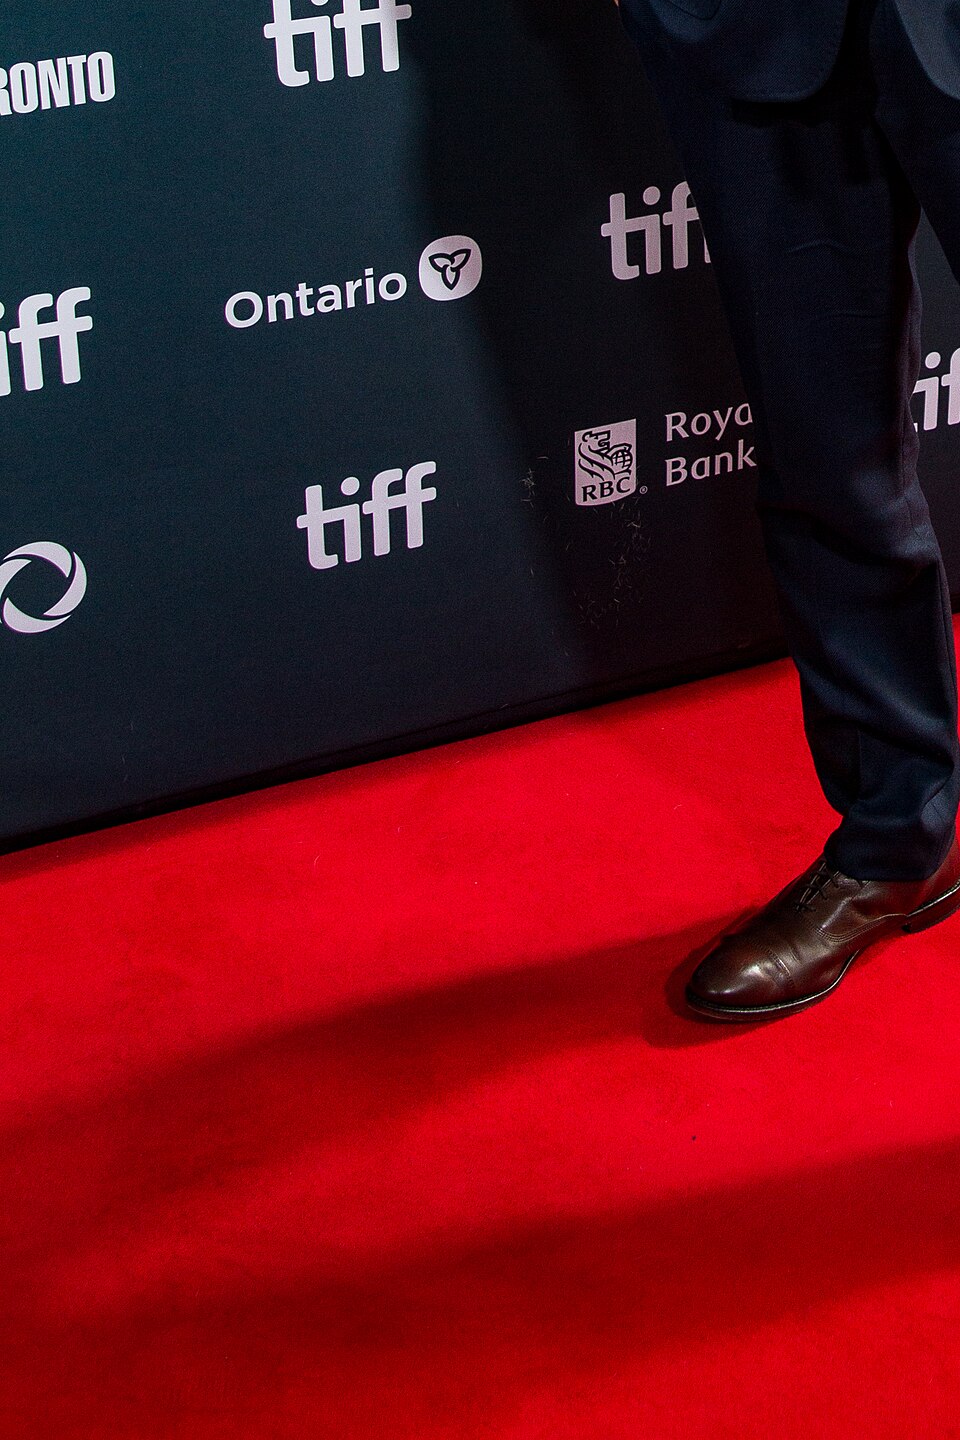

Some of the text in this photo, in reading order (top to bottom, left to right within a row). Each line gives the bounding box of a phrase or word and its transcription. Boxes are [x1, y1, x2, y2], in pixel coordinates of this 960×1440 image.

[224, 267, 408, 329] Ontario
[581, 476, 631, 503] RBC
[664, 438, 757, 487] Bank
[296, 460, 437, 570] tiff
